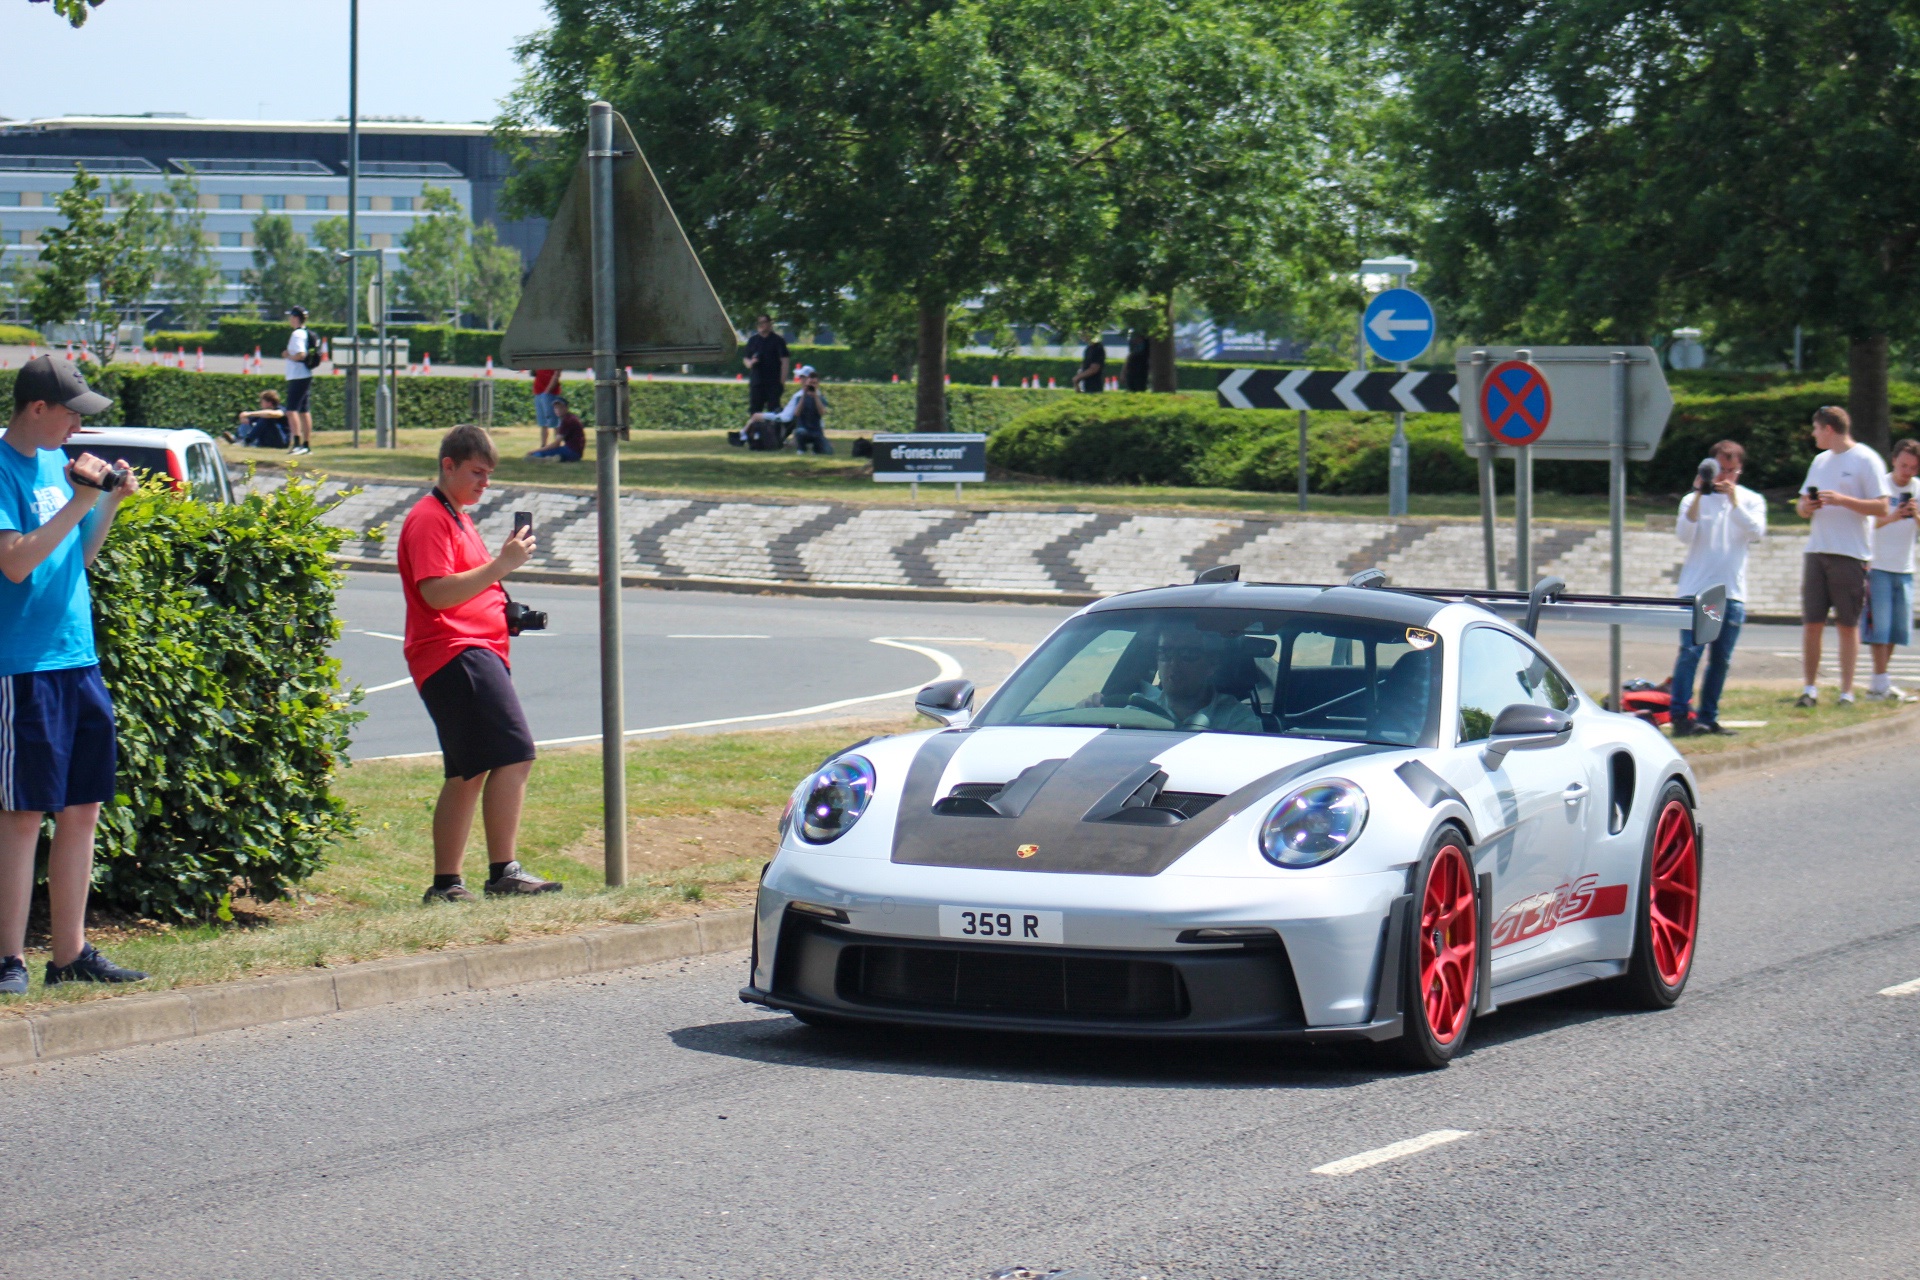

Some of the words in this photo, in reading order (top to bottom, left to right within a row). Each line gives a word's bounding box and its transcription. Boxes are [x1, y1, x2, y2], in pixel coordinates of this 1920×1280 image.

[890, 445, 964, 459] eFones.com
[961, 911, 1012, 937] 359
[1023, 914, 1039, 938] R
